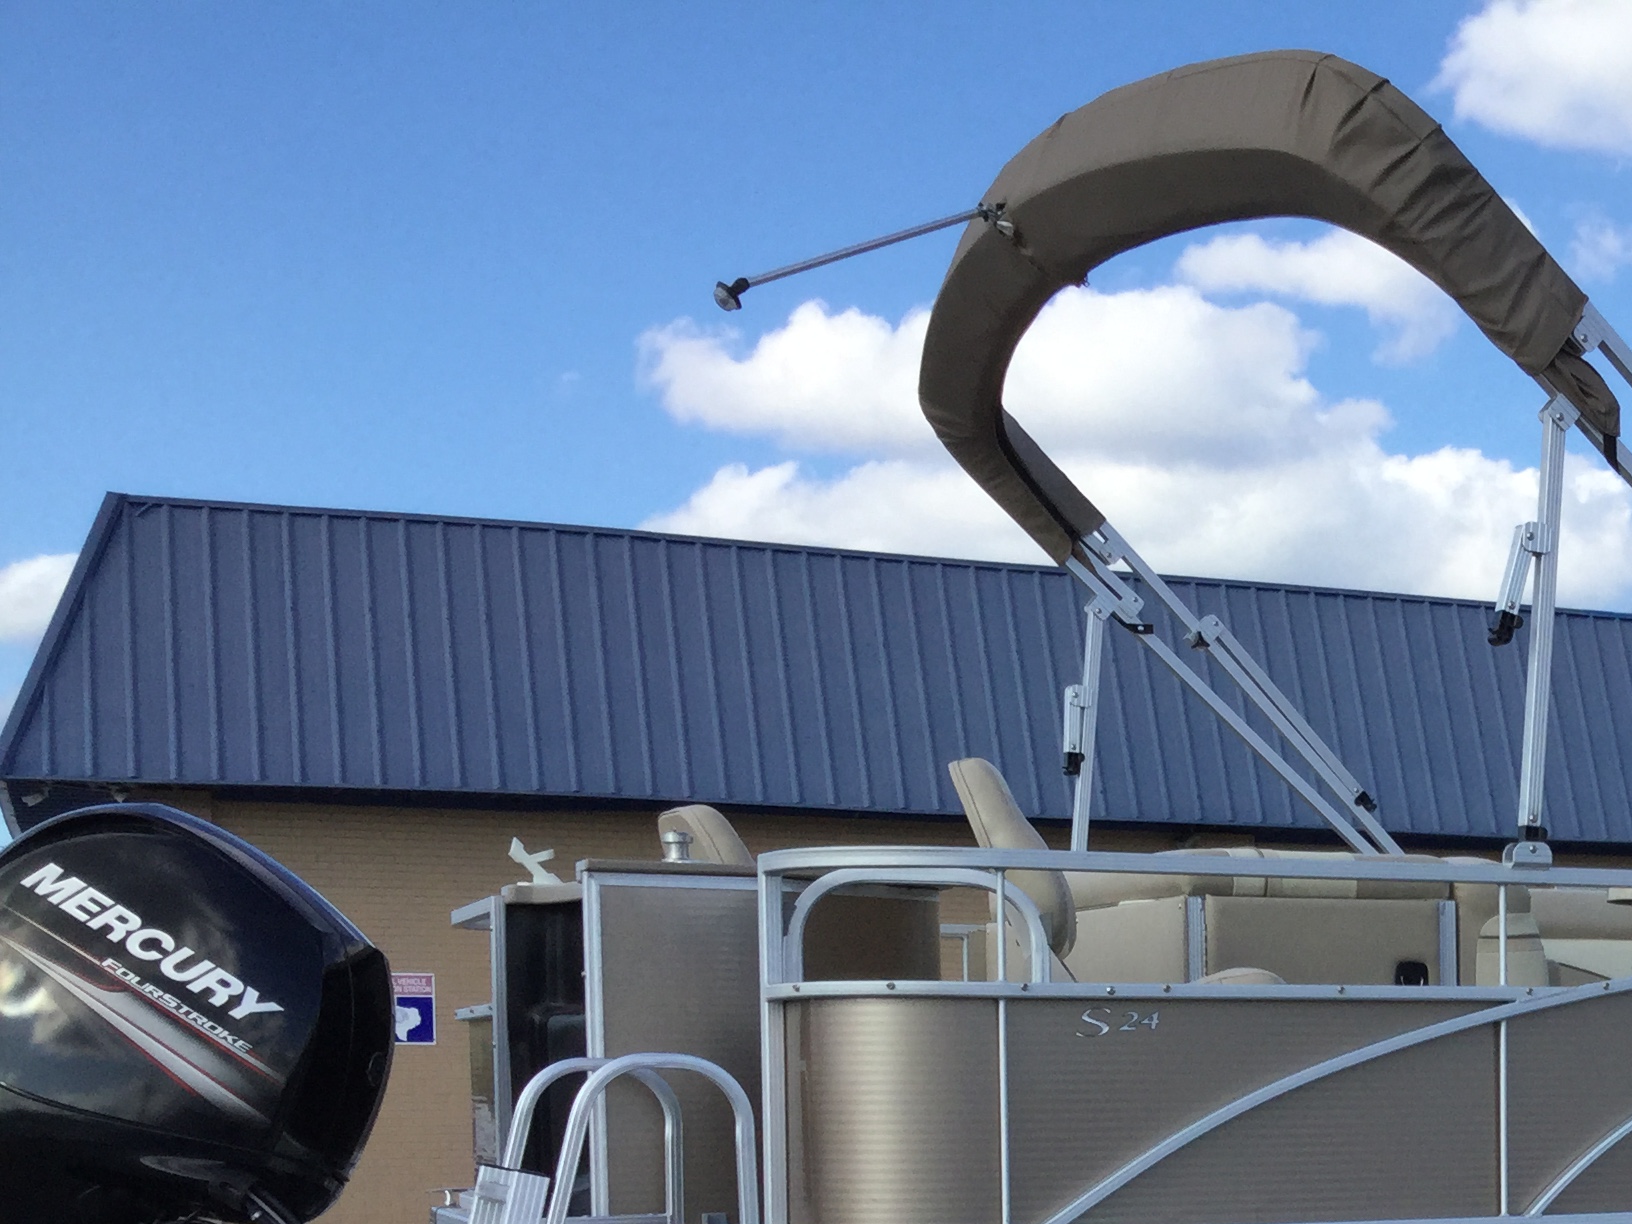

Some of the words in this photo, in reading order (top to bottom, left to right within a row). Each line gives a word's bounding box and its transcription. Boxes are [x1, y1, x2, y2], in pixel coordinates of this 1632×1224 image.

[20, 862, 284, 1020] MERCURY
[397, 977, 426, 986] VEHICLE
[403, 985, 432, 993] STATION
[101, 957, 253, 1054] FOURSTROKE
[1118, 1010, 1161, 1032] 24
